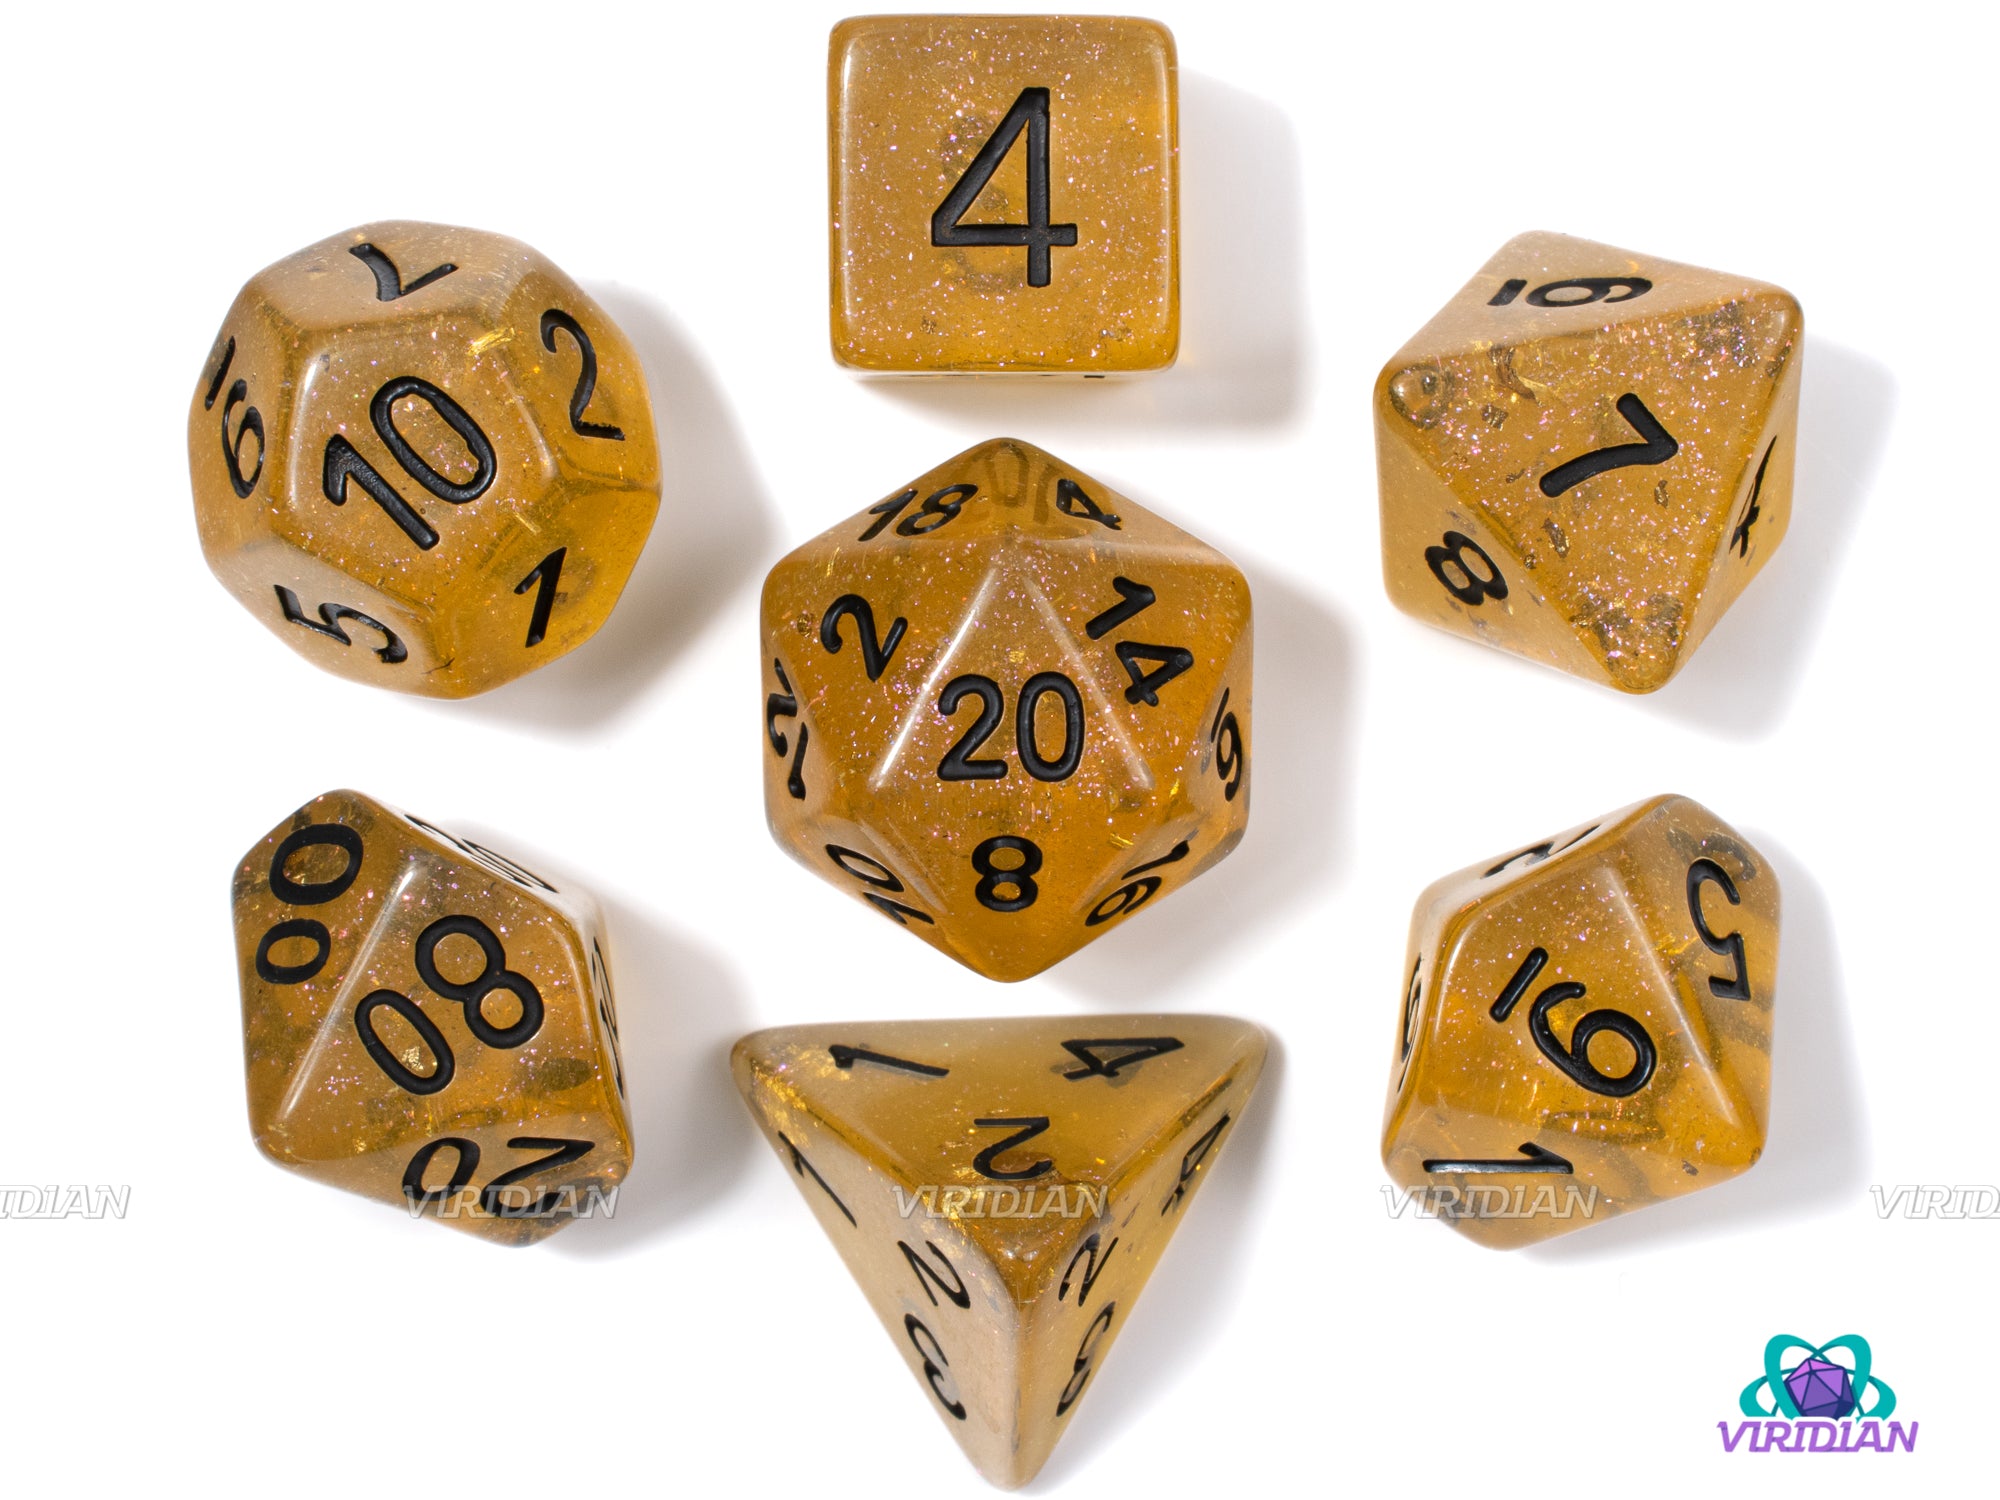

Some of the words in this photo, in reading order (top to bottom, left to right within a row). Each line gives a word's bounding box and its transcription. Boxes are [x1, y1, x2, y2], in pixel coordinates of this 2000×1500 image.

[931, 86, 1078, 288] 4
[349, 243, 459, 302] 7
[540, 308, 626, 441] 2
[322, 375, 497, 551] 10
[1539, 392, 1679, 498] 7
[857, 483, 978, 542] 18
[1056, 477, 1121, 531] 4
[513, 547, 567, 649] 1
[1424, 530, 1509, 606] 8
[273, 584, 409, 664] 5
[820, 593, 908, 682] 2
[1085, 576, 1194, 707] 14
[937, 671, 1086, 782] 20
[255, 823, 364, 985] 00
[971, 835, 1043, 912] 8
[1085, 839, 1191, 927] 16
[1685, 857, 1752, 1002] 5
[354, 914, 545, 1096] 80
[828, 1044, 950, 1077] 1
[1061, 1037, 1185, 1082] 4
[402, 1136, 596, 1220] 20
[777, 1130, 858, 1229] 1
[972, 1116, 1054, 1181] 2
[1422, 1141, 1575, 1175] 1
[896, 1239, 972, 1310] 2
[1058, 1233, 1119, 1308] 2
[904, 1313, 967, 1421] 3
[1056, 1300, 1116, 1418] 3
